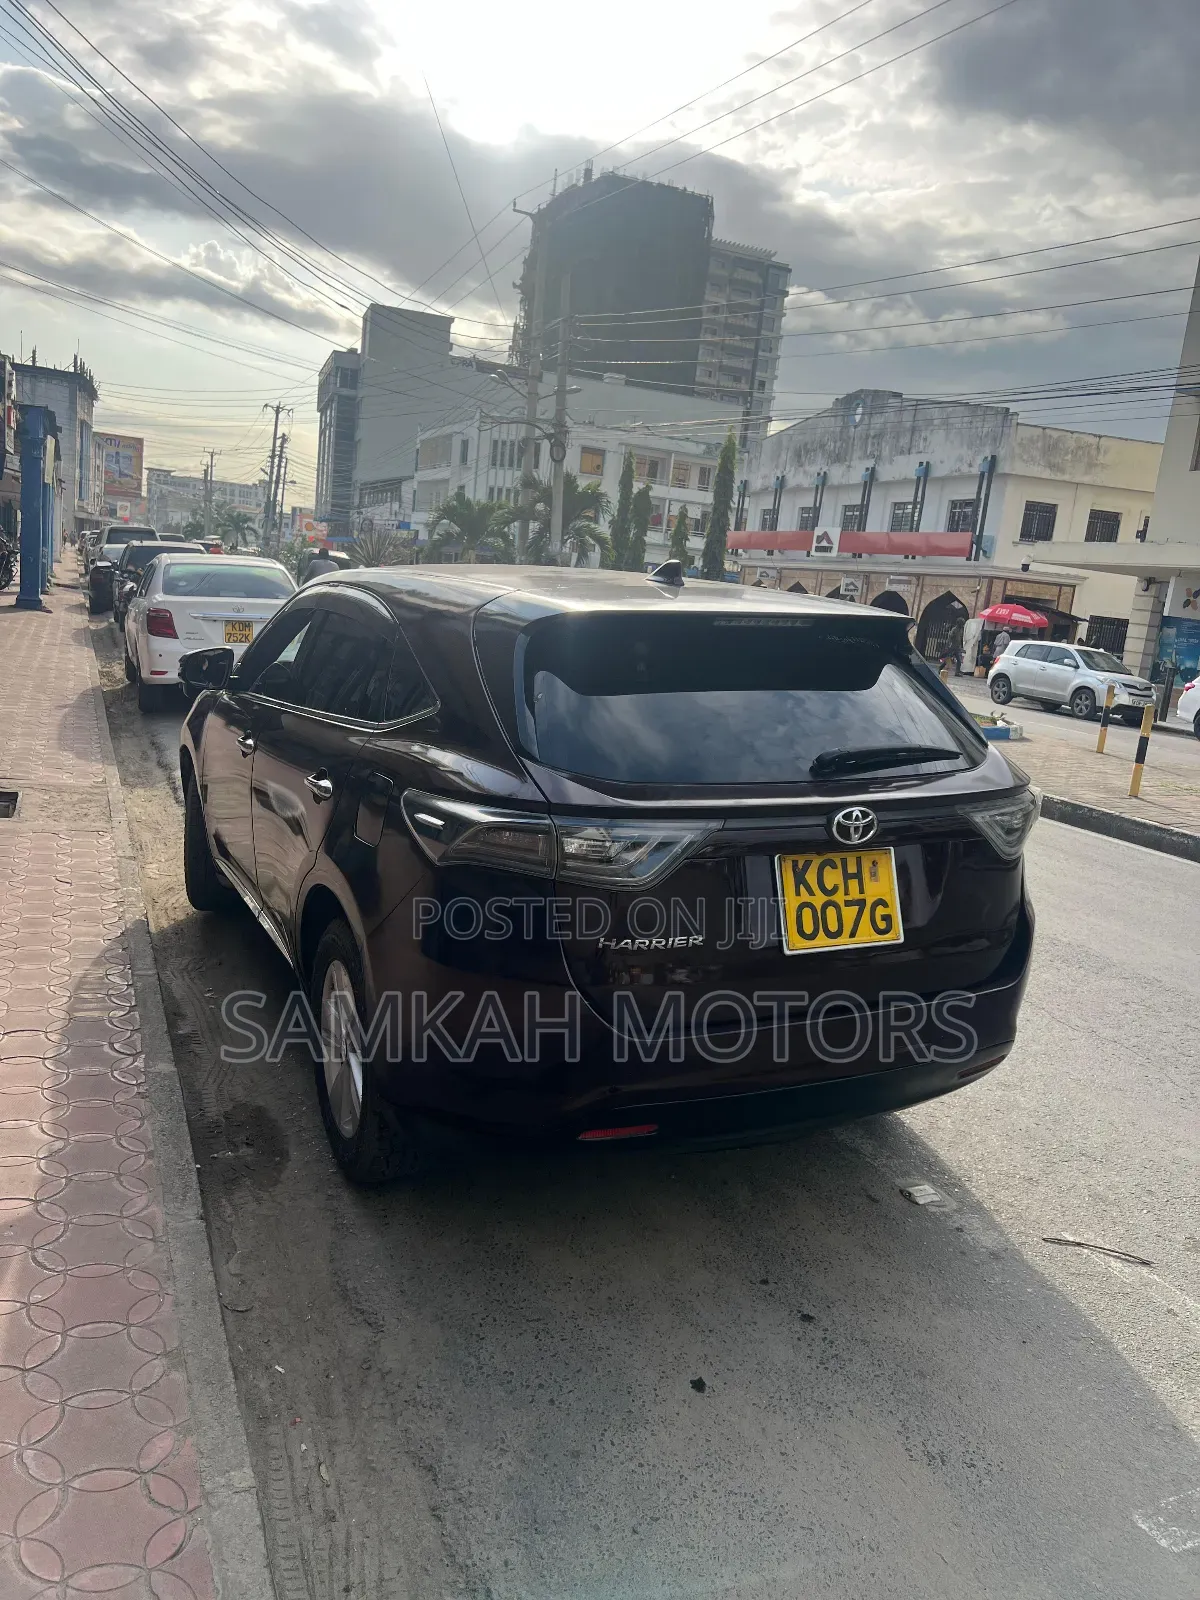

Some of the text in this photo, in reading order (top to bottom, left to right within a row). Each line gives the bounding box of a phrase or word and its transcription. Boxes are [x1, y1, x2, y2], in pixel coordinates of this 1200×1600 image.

[231, 622, 251, 632] KDM
[226, 632, 251, 643] 752K
[791, 855, 865, 897] KCH
[795, 897, 893, 941] 007G
[597, 935, 705, 951] HARRIER
